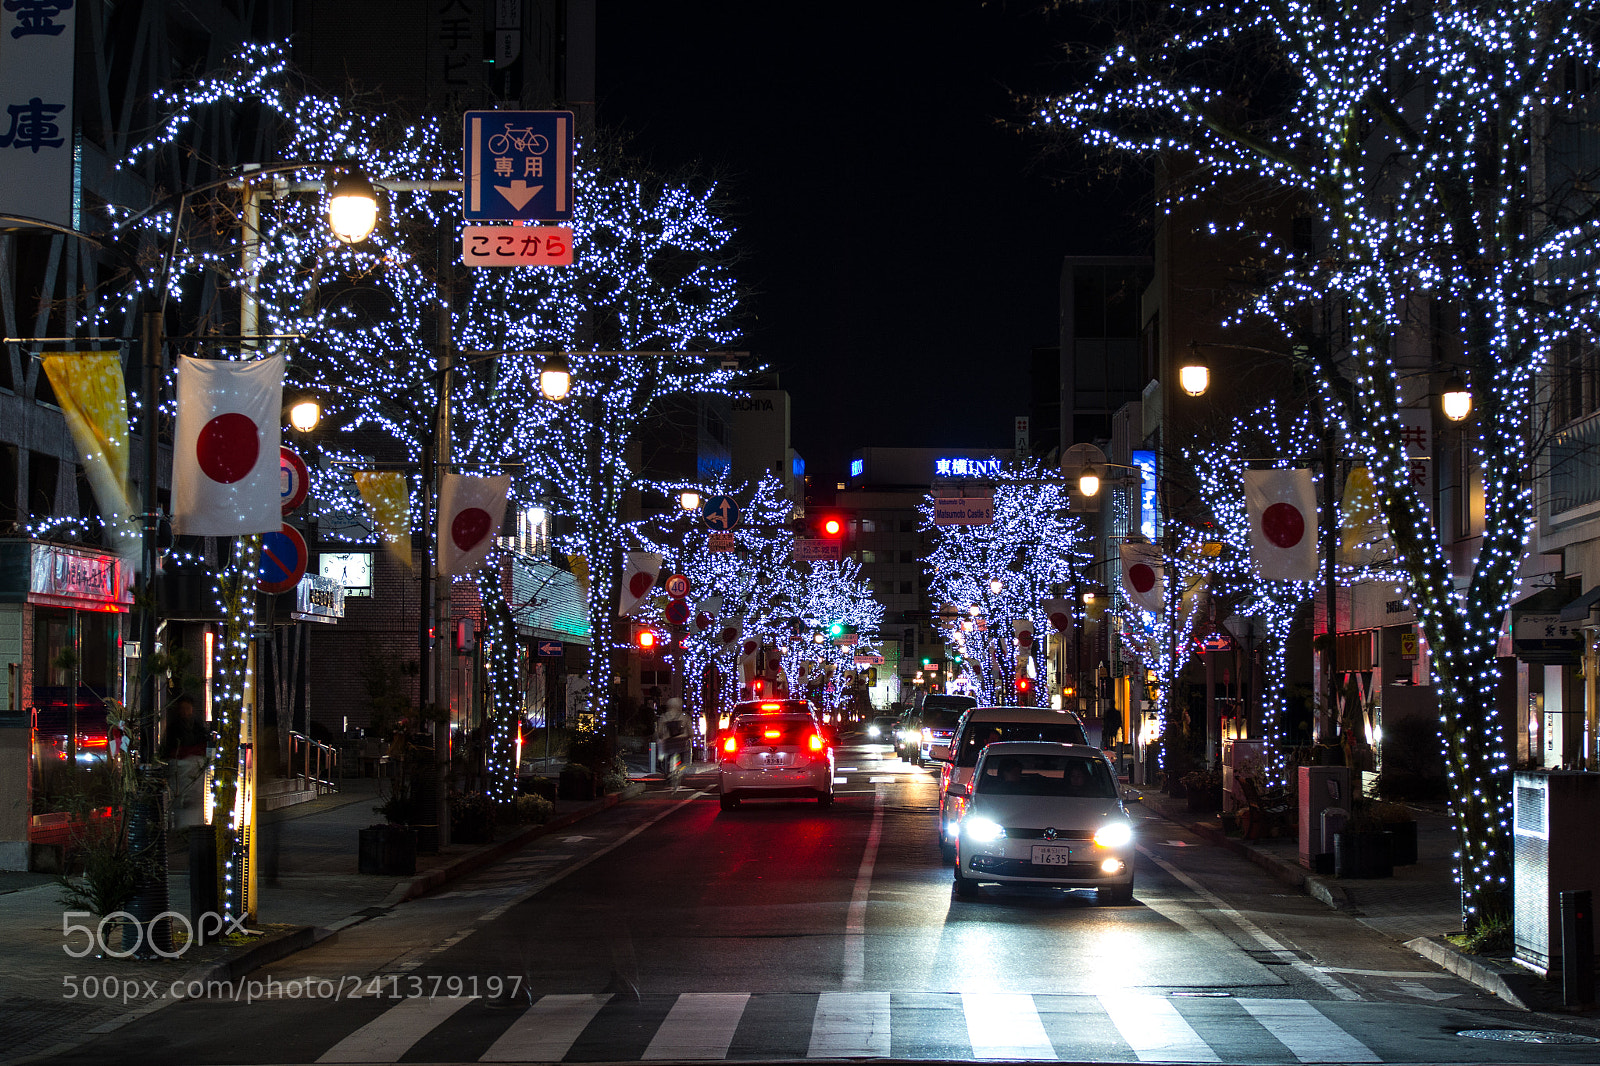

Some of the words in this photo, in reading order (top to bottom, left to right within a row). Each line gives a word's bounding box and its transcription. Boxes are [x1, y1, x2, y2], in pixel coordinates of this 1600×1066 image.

[493, 156, 543, 178] 専用
[470, 235, 566, 257] ここから
[935, 458, 1002, 475] 東横INN
[936, 509, 966, 519] Matsumoto
[967, 509, 984, 519] Castle
[671, 581, 685, 592] 40
[1040, 853, 1067, 864] 16-35
